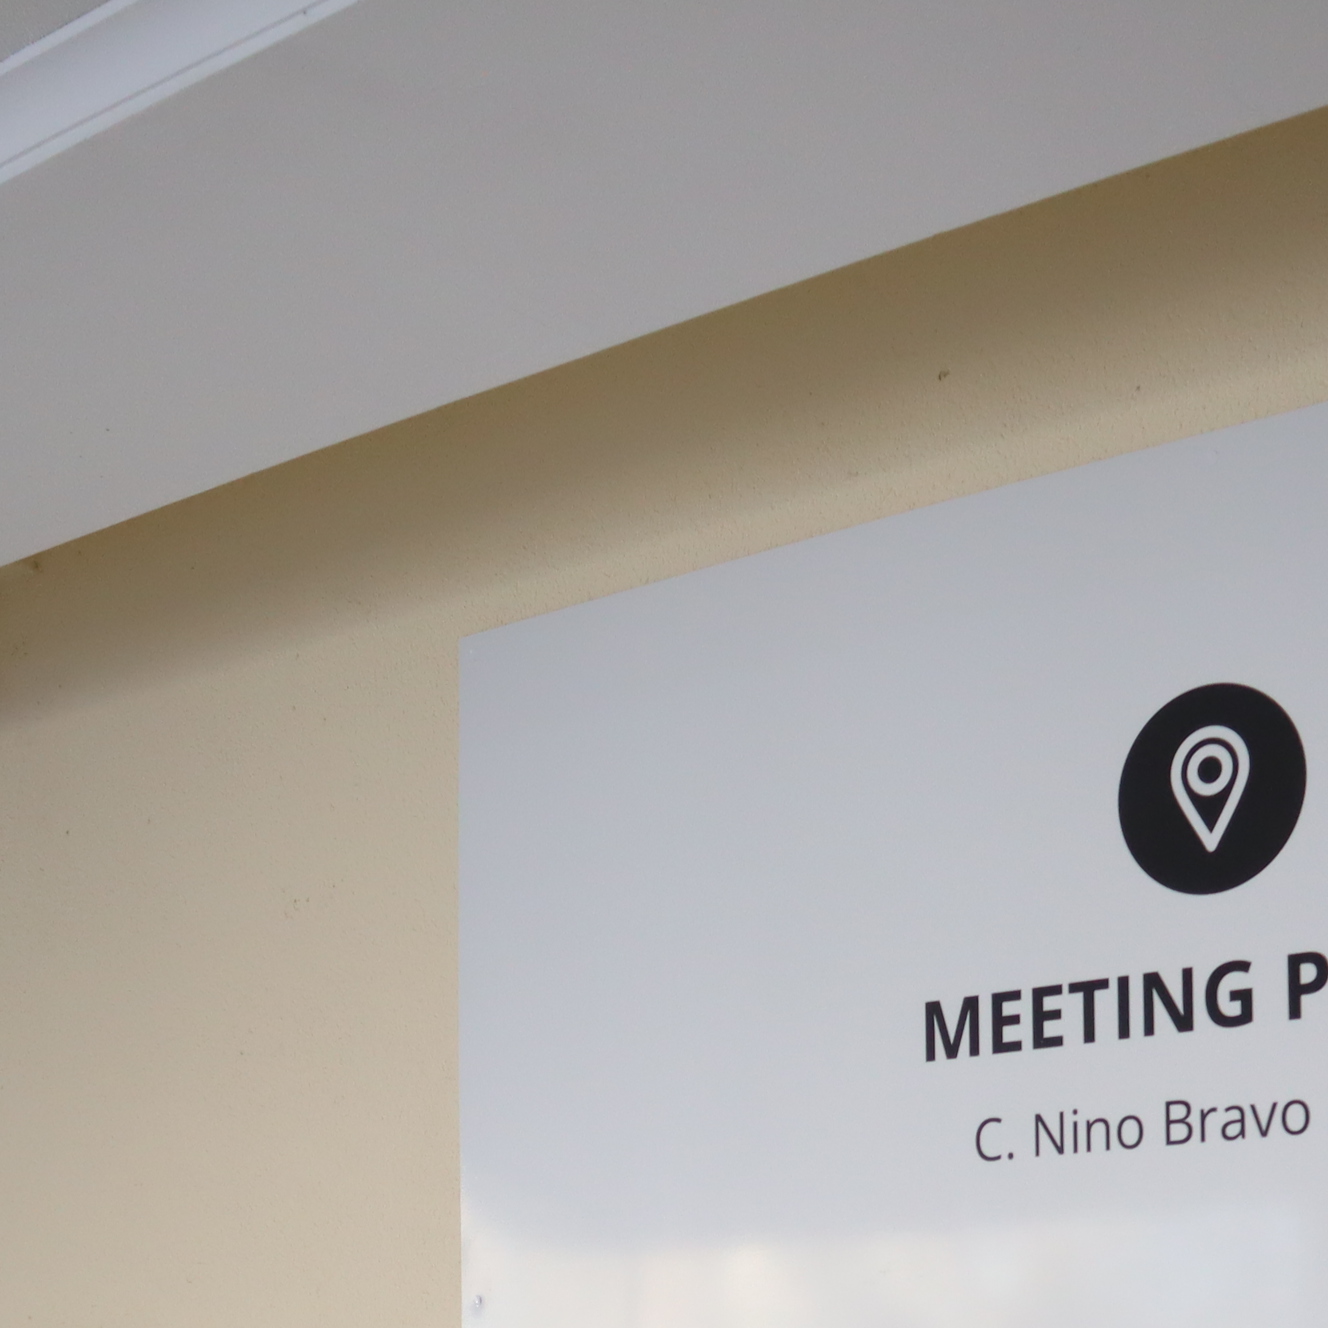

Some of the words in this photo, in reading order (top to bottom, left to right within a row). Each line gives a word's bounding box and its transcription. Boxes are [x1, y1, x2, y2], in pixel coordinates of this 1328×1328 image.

[925, 959, 1254, 1063] MEETING
[975, 1117, 1014, 1162] C.
[1034, 1108, 1144, 1158] Nino
[1164, 1099, 1311, 1146] Bravo
